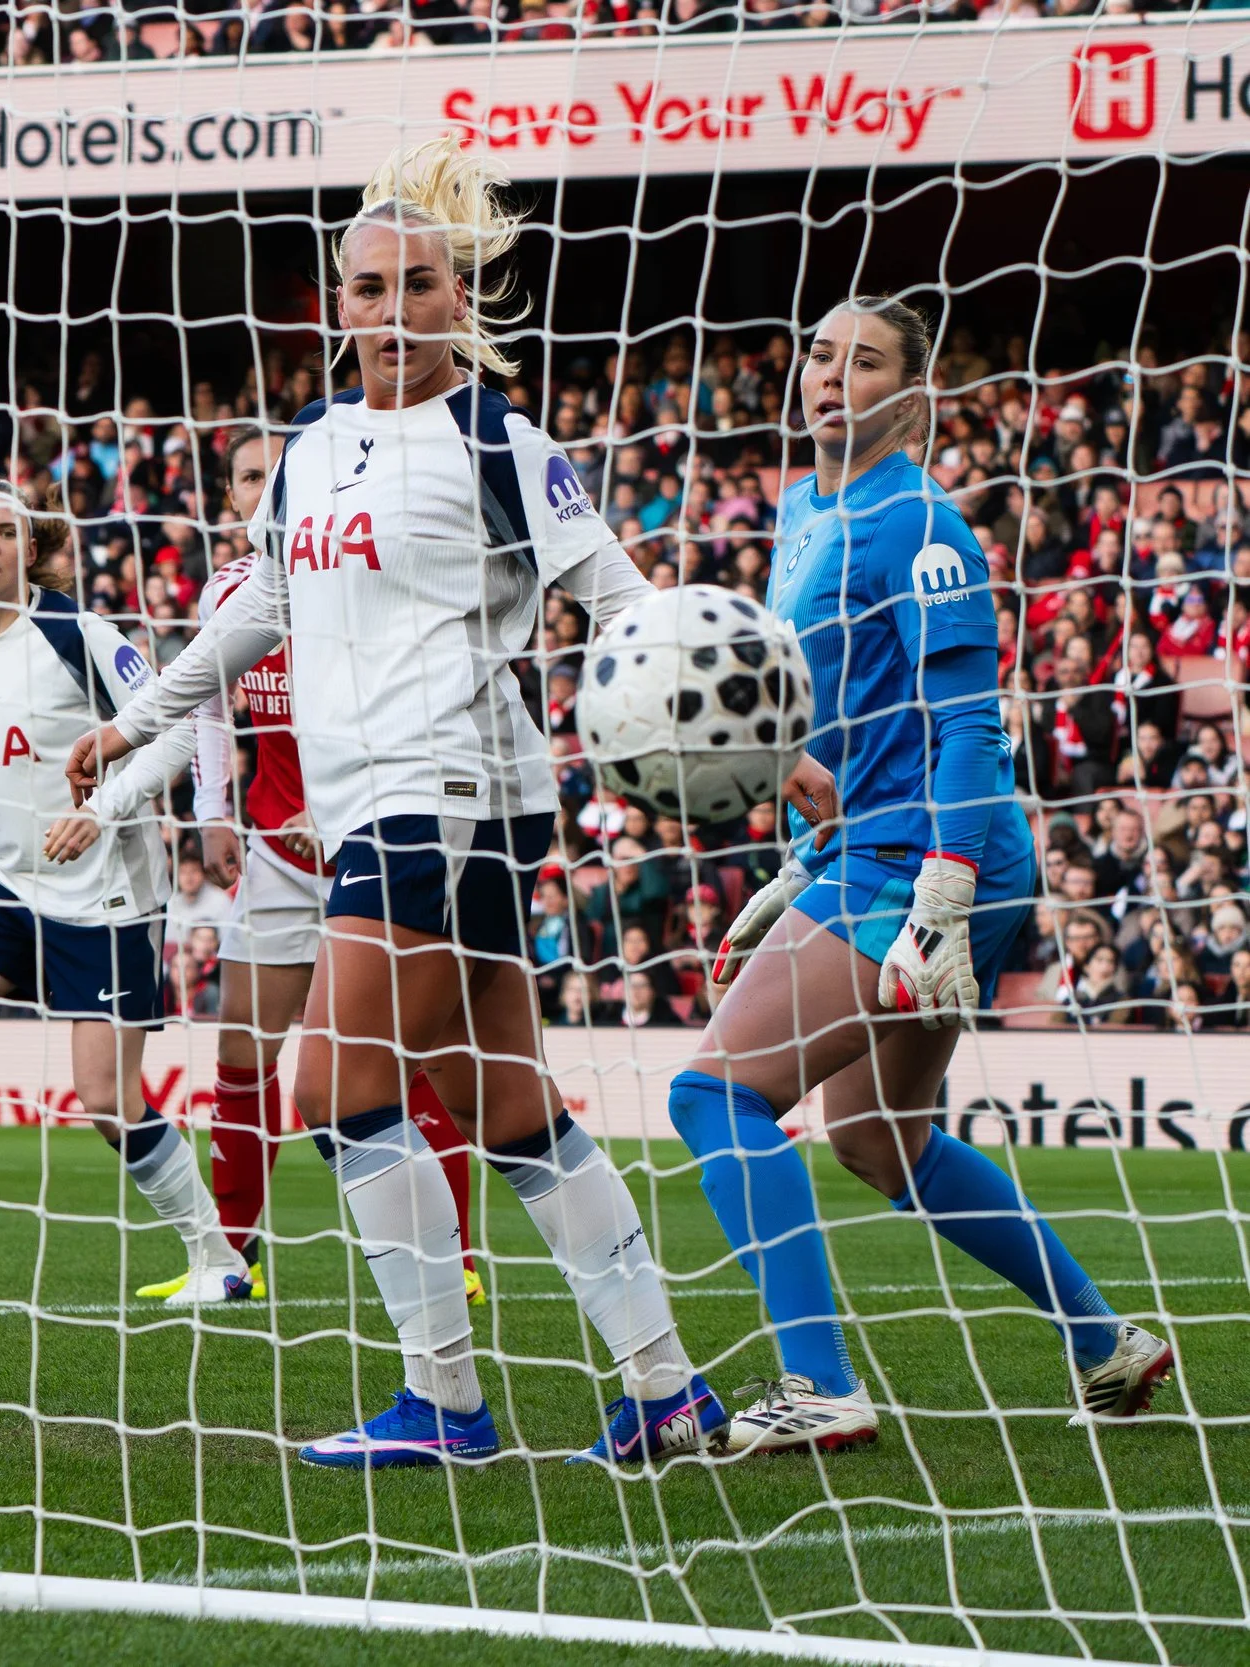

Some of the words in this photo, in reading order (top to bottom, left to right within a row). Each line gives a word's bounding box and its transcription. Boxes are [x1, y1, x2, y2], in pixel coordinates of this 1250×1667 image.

[441, 88, 599, 150] Save
[614, 82, 764, 143] Your
[289, 511, 382, 576] AIA
